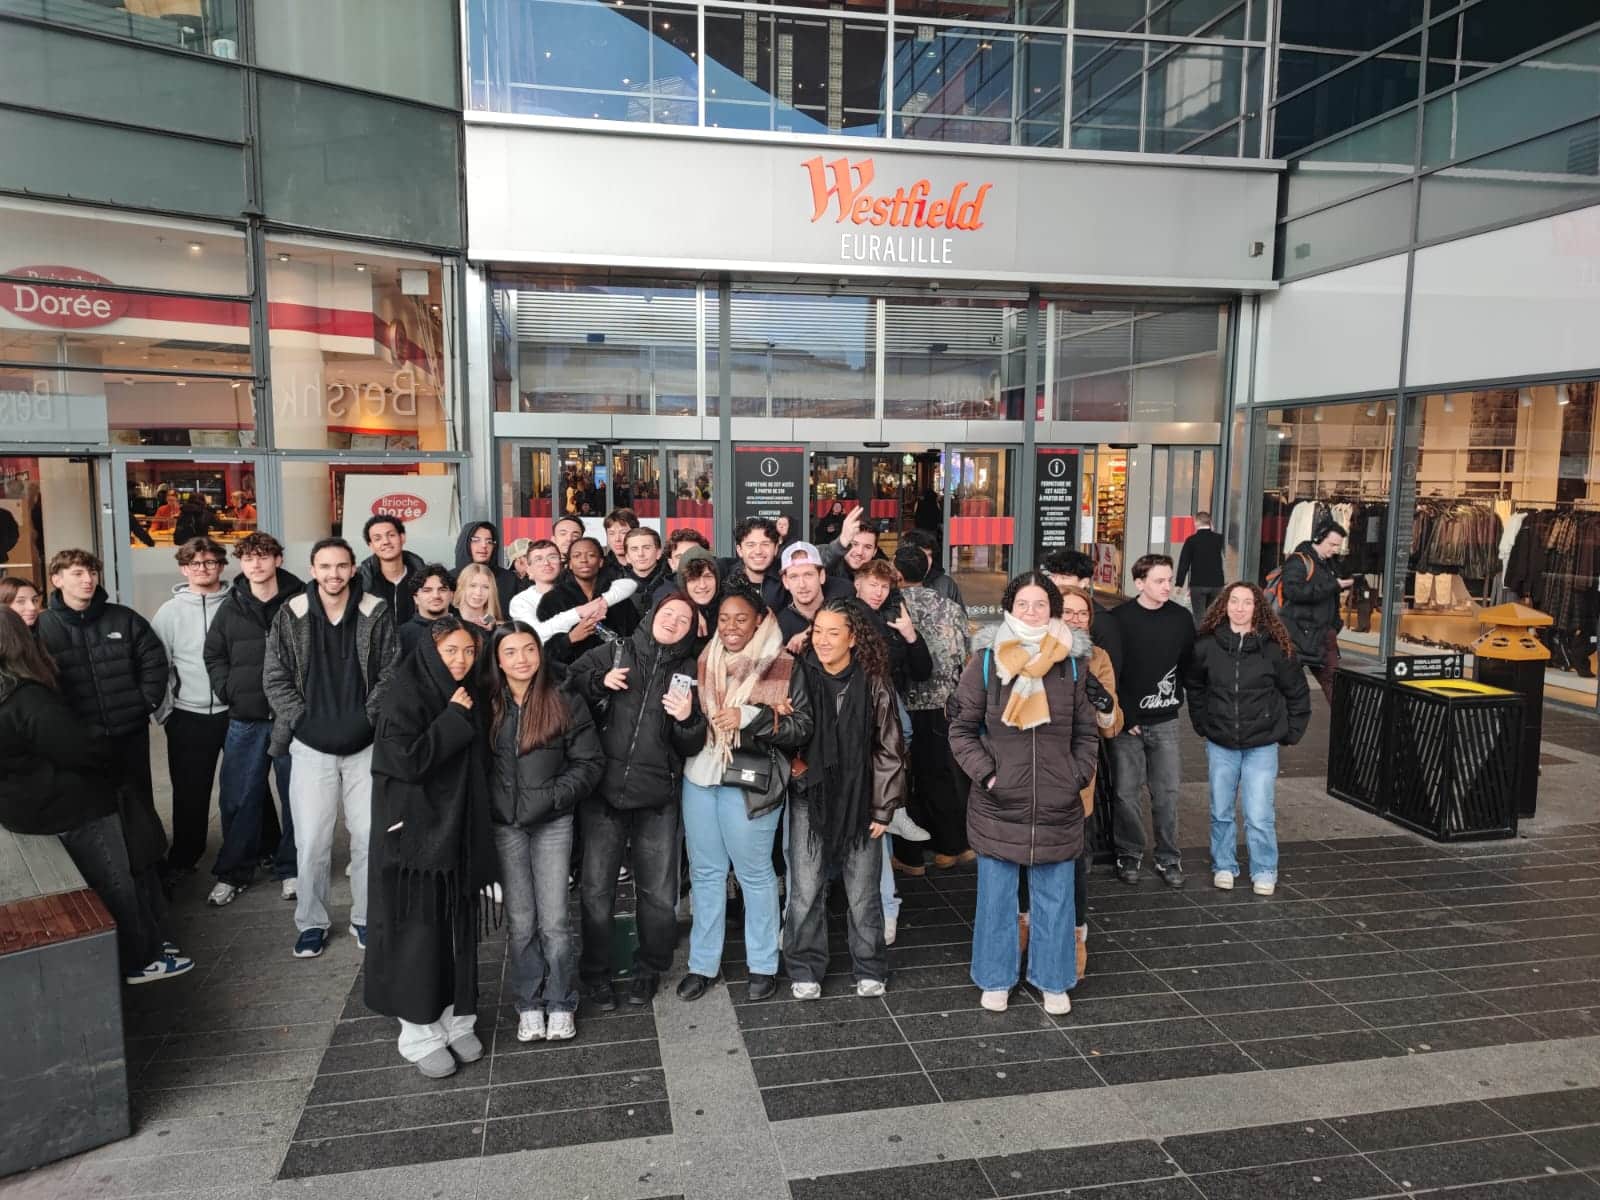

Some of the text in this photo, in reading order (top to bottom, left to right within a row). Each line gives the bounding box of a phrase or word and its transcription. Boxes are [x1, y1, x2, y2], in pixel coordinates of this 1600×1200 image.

[800, 155, 993, 231] Westfield
[840, 233, 953, 264] EURALILLE
[13, 284, 112, 318] Dorée
[382, 496, 419, 507] Brioche
